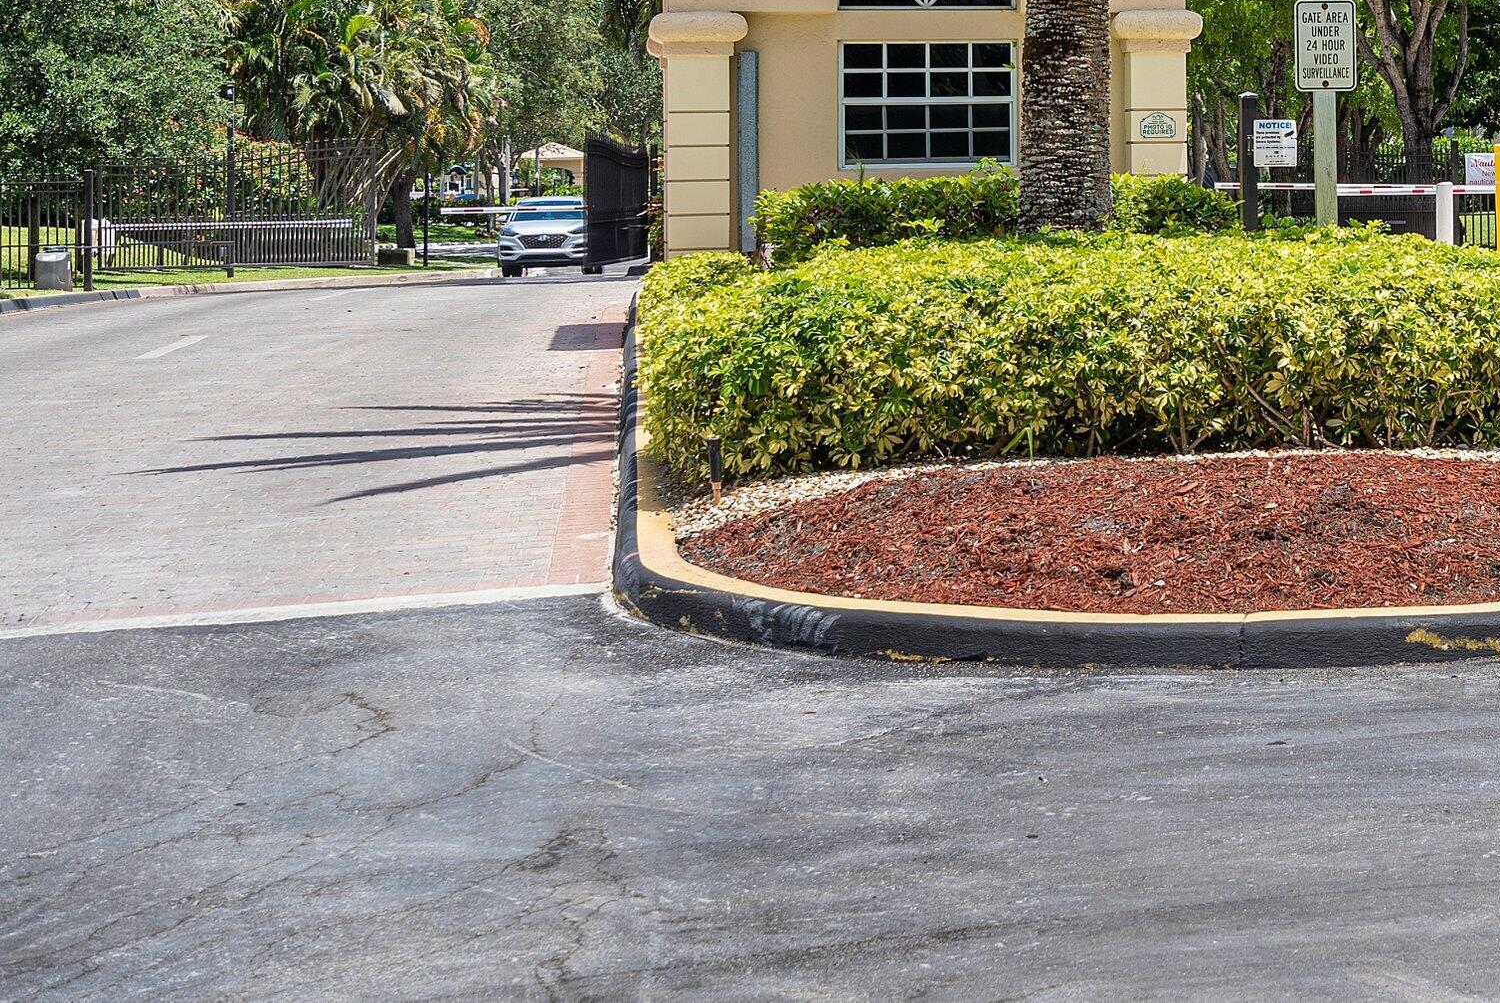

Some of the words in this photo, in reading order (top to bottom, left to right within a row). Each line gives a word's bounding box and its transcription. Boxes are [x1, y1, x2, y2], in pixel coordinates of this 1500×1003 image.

[1302, 12, 1321, 23] GATE
[1326, 12, 1348, 23] AREA
[1311, 26, 1339, 37] UNDER
[1306, 40, 1317, 51] 24
[1322, 40, 1345, 51] HOUR
[1313, 54, 1338, 64] VIDEO
[1302, 67, 1349, 78] SURVEILLANCE
